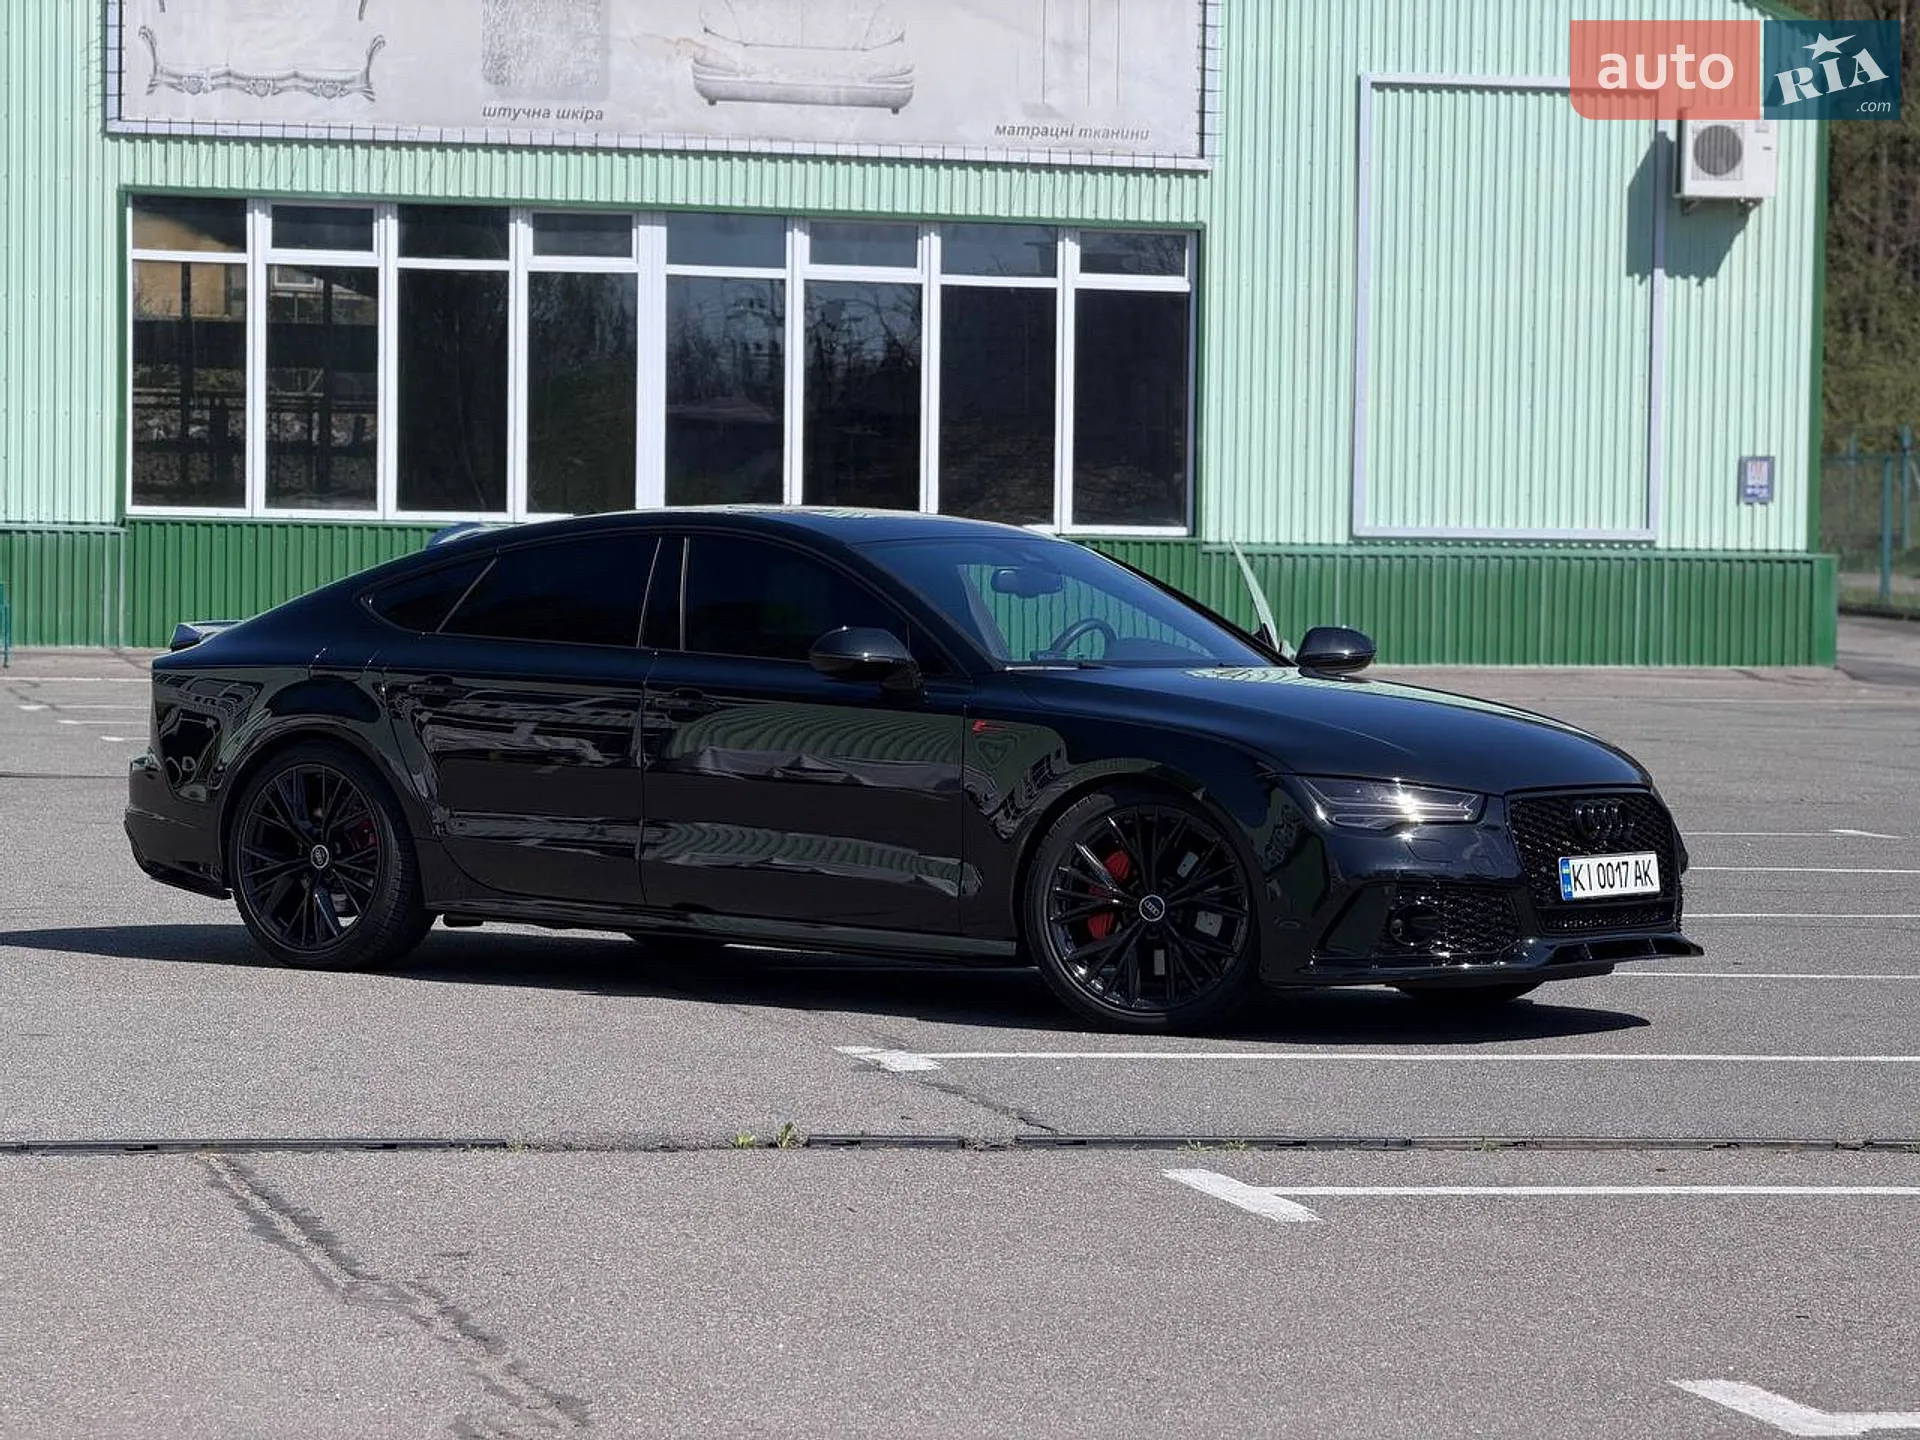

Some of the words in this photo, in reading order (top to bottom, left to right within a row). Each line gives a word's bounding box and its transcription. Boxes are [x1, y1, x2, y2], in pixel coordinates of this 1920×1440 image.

[482, 106, 551, 121] штучна
[556, 106, 604, 123] шкіра
[995, 123, 1074, 140] матрацні
[1078, 127, 1150, 141] тканини
[1572, 863, 1592, 891] KI
[1596, 861, 1629, 889] 0017
[1634, 859, 1654, 887] AK
